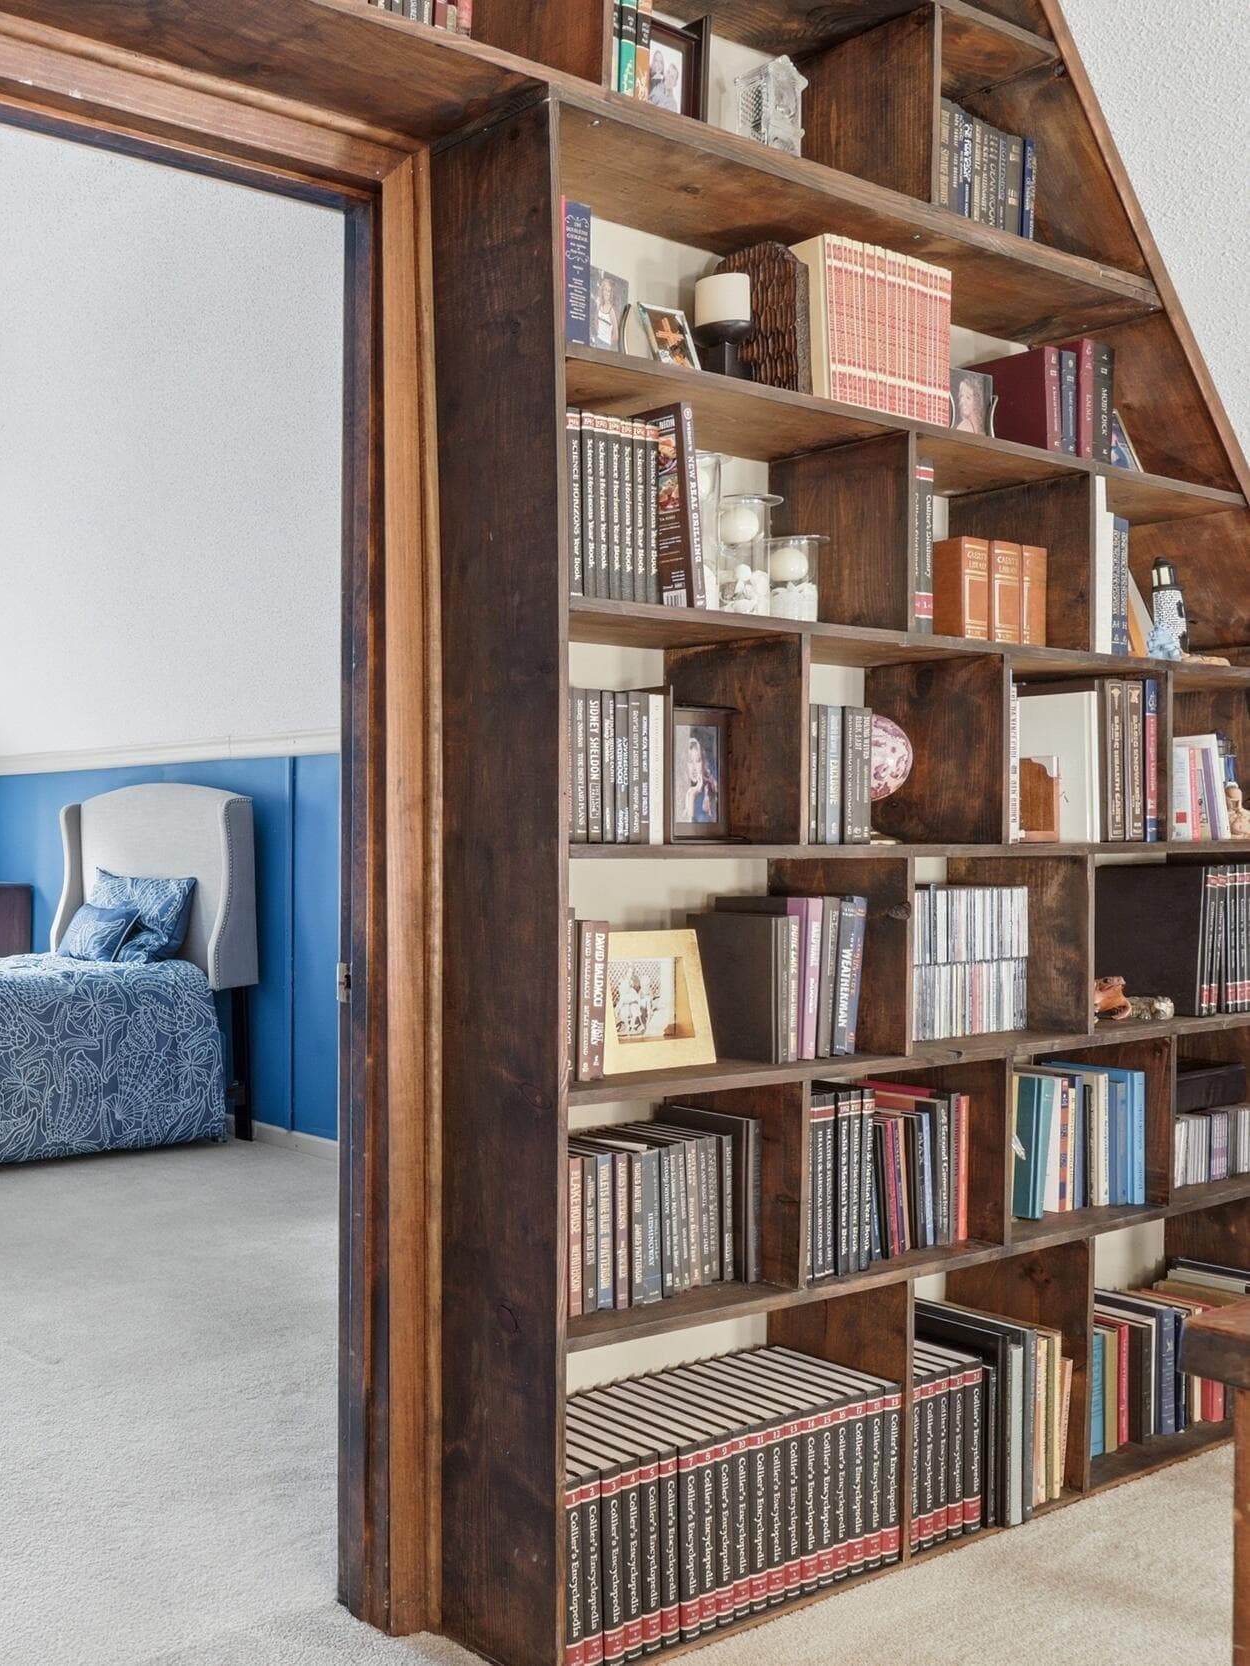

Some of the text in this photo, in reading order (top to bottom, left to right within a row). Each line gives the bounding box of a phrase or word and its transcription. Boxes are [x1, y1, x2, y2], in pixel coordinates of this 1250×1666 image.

[687, 455, 695, 479] NEW
[690, 481, 698, 510] REAL
[590, 700, 599, 780] SIDNEY SHELDON
[594, 933, 606, 1007] DAVID BALDACCI
[838, 949, 853, 1027] WEATHERMAN
[856, 1407, 863, 1415] 17
[773, 1430, 781, 1438] 12
[668, 1463, 673, 1471] 6
[650, 1468, 655, 1477] 5
[631, 1475, 635, 1483] 4
[611, 1482, 616, 1491] 3
[590, 1488, 595, 1496] 2
[571, 1494, 576, 1503] 1
[589, 1505, 598, 1552] Collier's
